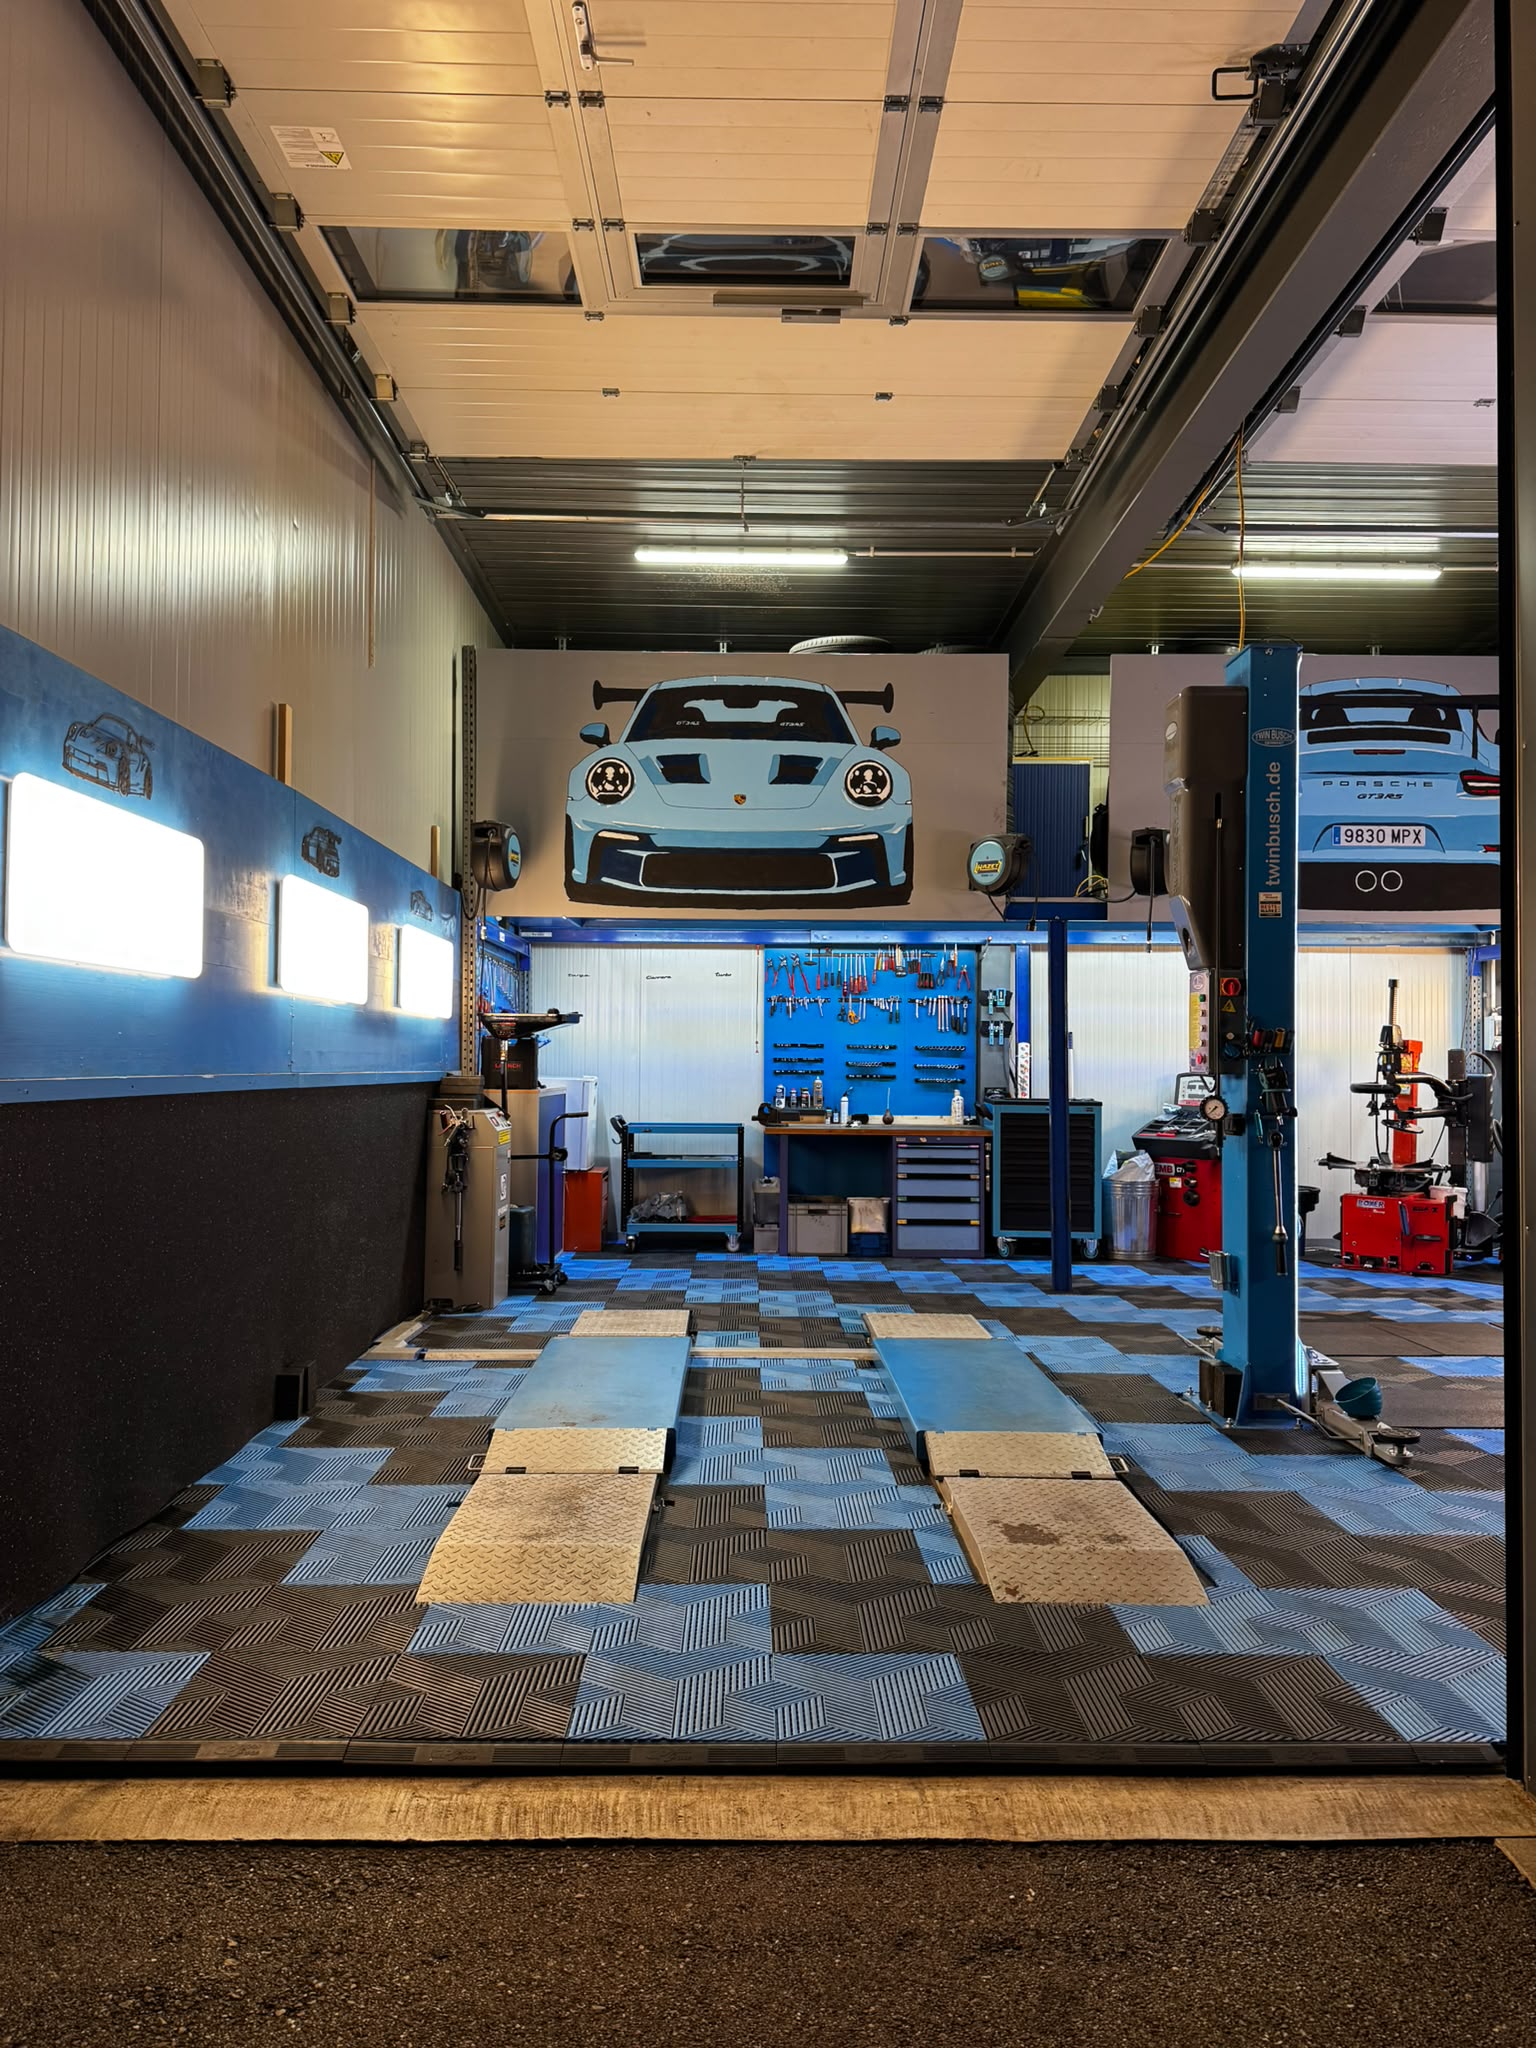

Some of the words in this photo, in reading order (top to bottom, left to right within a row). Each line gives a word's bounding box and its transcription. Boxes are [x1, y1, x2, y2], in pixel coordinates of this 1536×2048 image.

[1255, 730, 1270, 741] TWIN
[1271, 729, 1292, 740] BUSCH
[1322, 780, 1434, 788] PORSCHE
[1265, 761, 1281, 886] twinbusch.de
[1344, 828, 1386, 844] 9830
[1391, 828, 1422, 844] MPX
